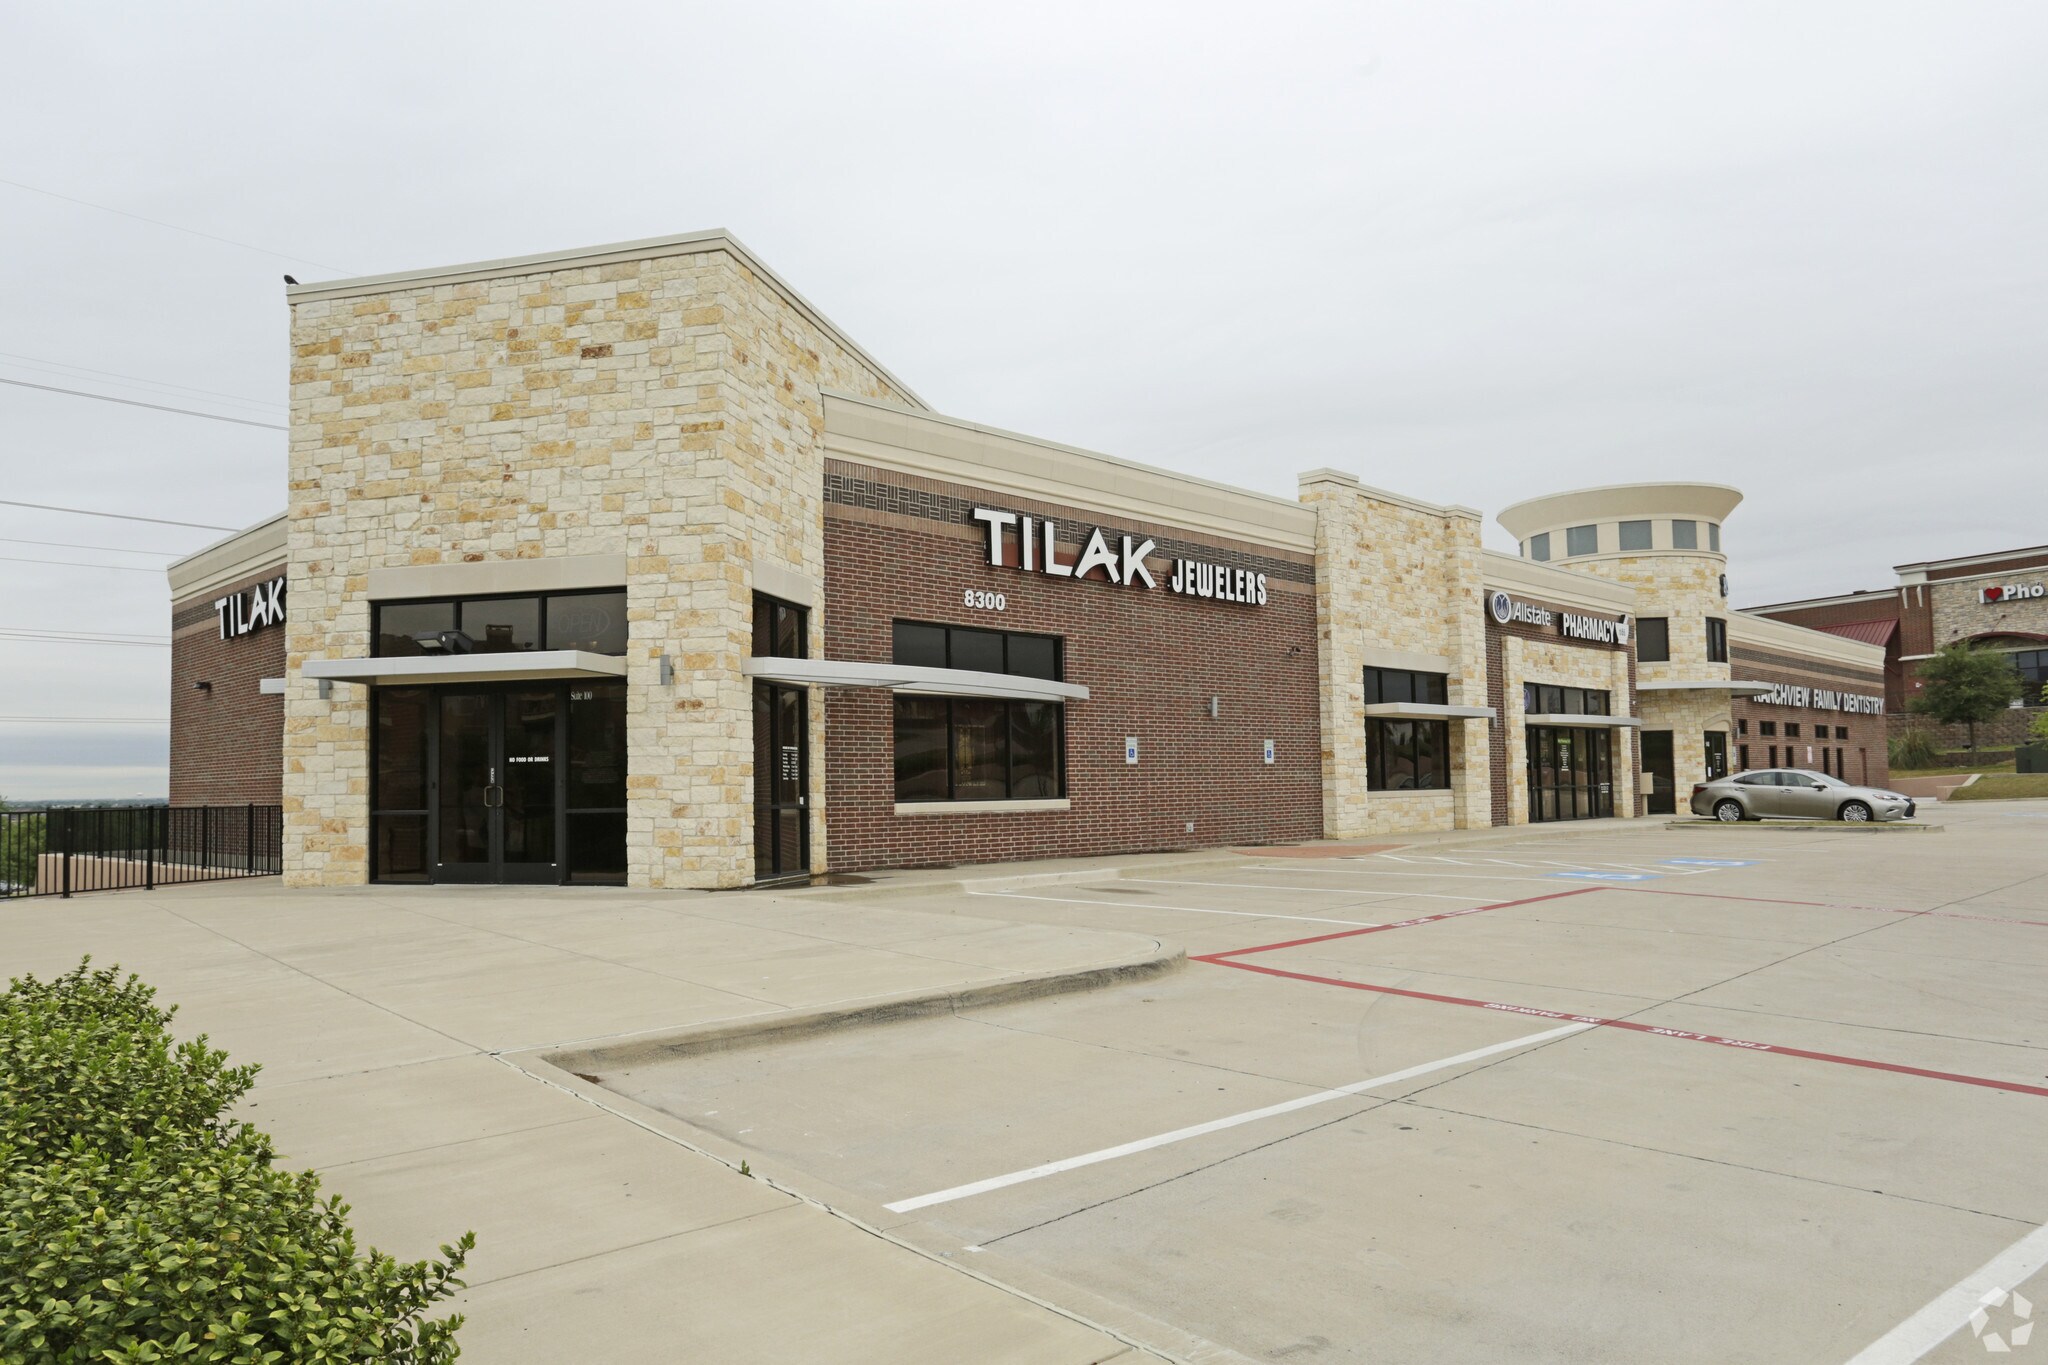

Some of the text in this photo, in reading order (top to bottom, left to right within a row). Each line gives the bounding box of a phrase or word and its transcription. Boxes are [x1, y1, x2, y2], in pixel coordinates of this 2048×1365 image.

[974, 508, 1266, 606] TILAK JEWELERS
[215, 577, 284, 640] TILAK
[964, 590, 1006, 611] 8300
[1512, 601, 1551, 627] Allstate
[1563, 613, 1616, 643] PHARMACY
[570, 691, 583, 701] Suite
[1813, 689, 1842, 711] FAMILY
[1843, 693, 1885, 715] DENTISTRY
[1647, 1026, 1707, 1041] LANE
[1714, 1038, 1772, 1051] FIRE
